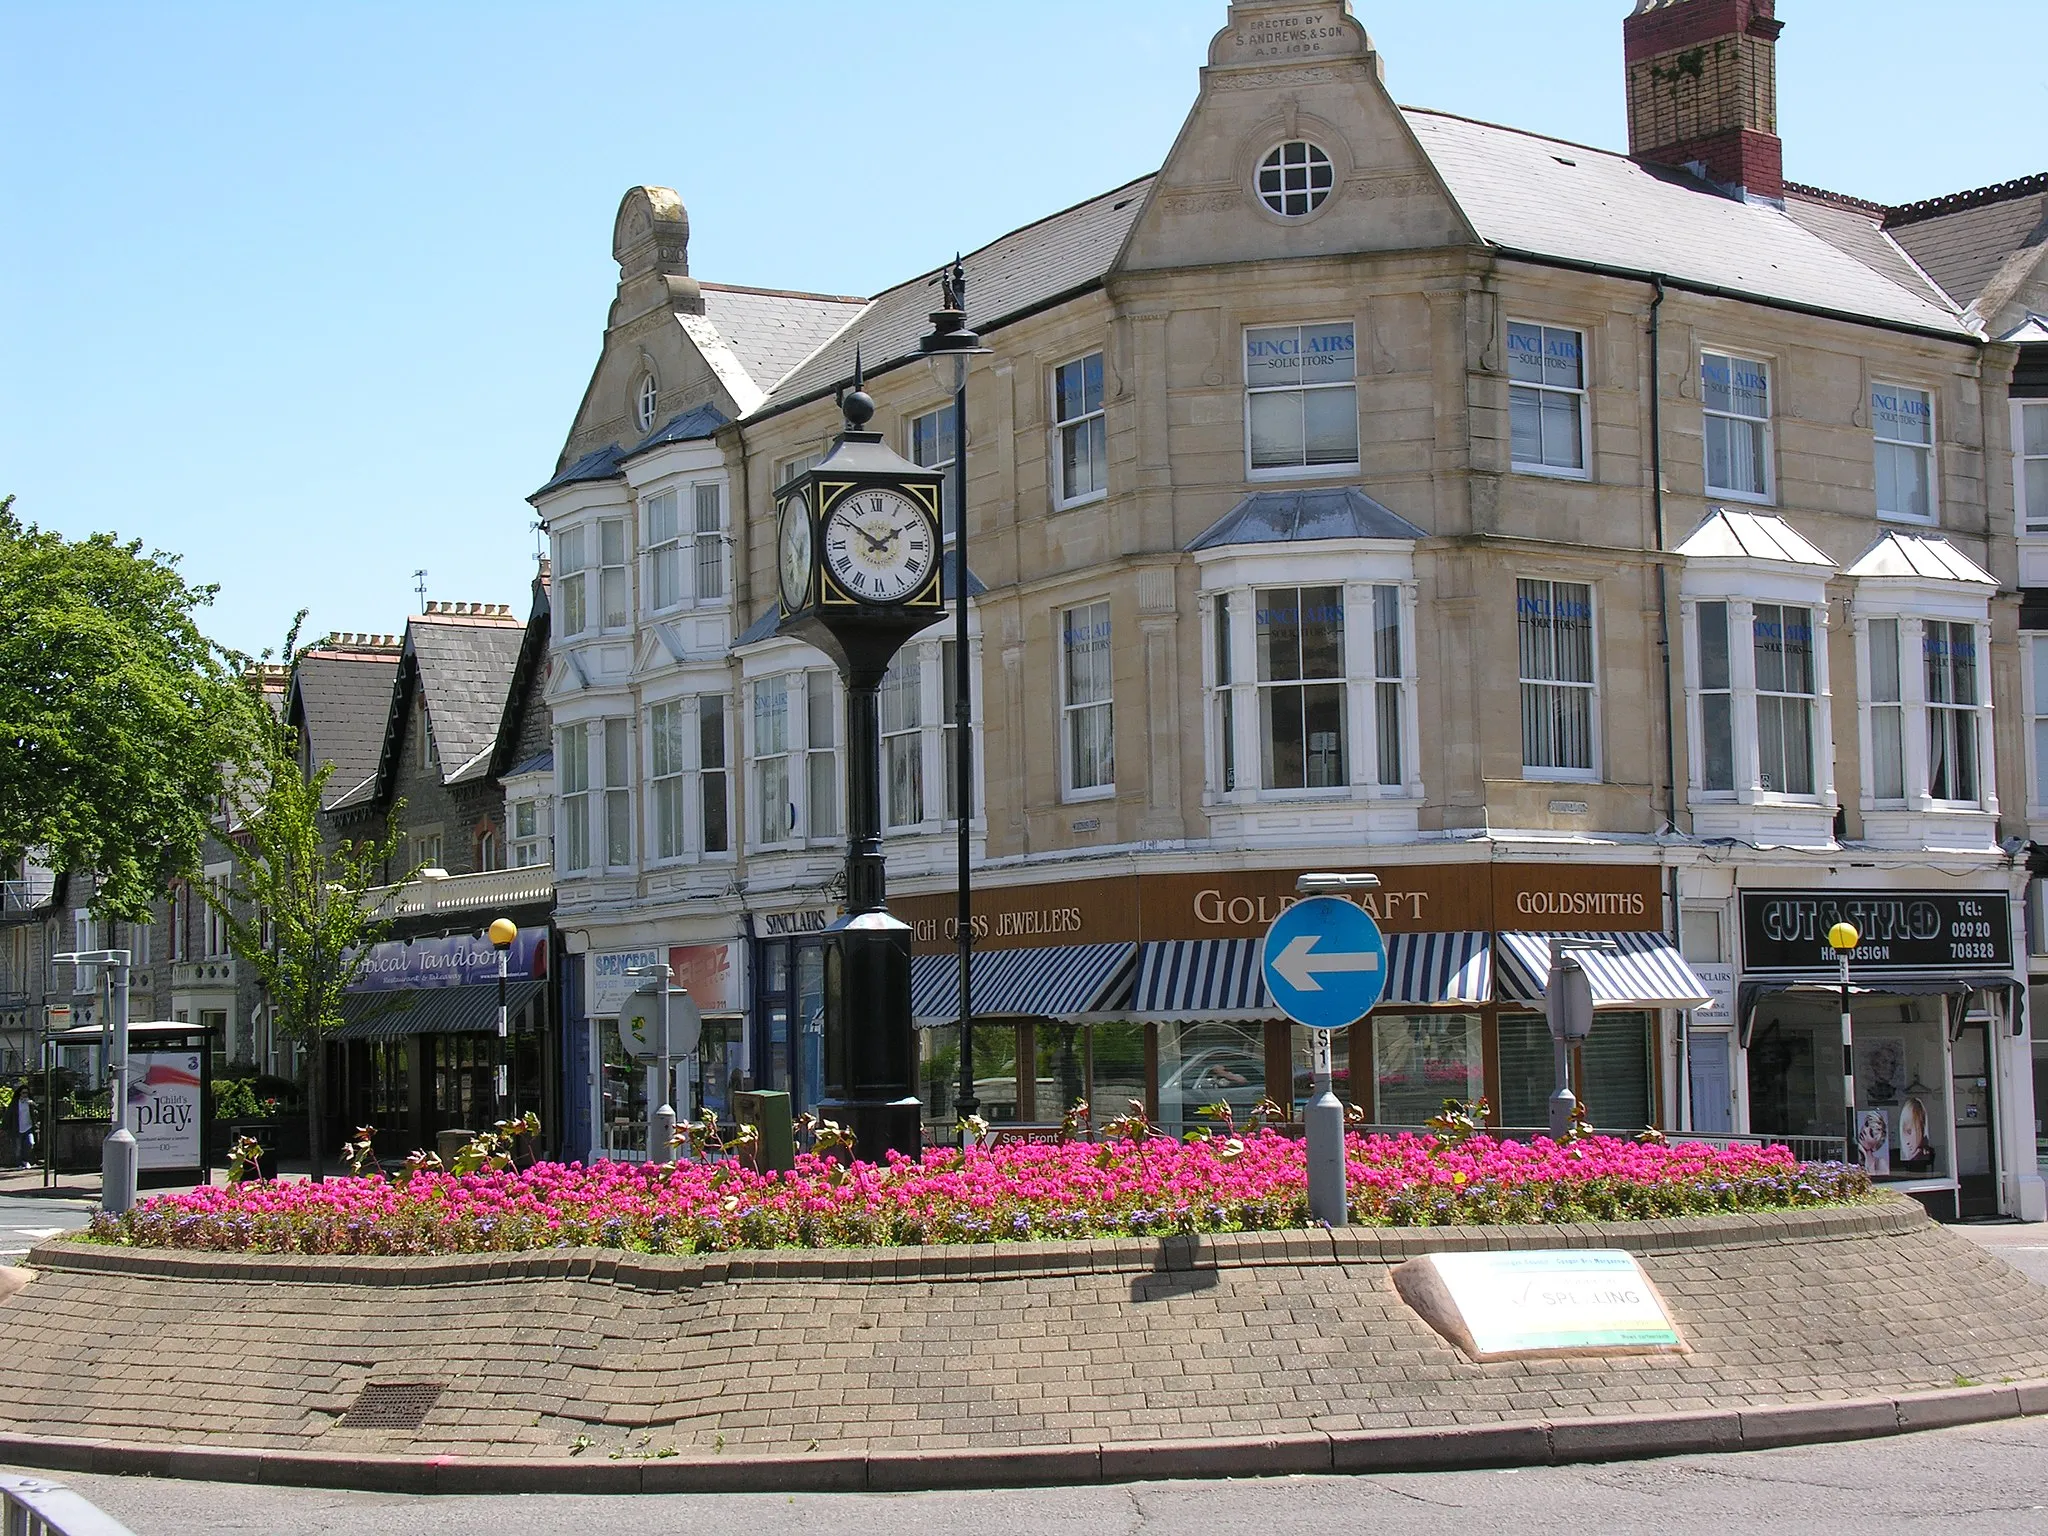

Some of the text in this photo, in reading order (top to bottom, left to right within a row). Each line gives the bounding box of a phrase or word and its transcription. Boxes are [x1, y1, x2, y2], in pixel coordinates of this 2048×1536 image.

[1250, 15, 1323, 30] ERECTED BY
[1248, 335, 1354, 357] SINCLAIRS
[1507, 334, 1583, 358] INCLAIRS
[1268, 354, 1334, 368] SOLICITORS
[1519, 353, 1567, 369] SOLICITORS
[851, 502, 865, 518] XI
[870, 498, 883, 512] XII
[832, 540, 846, 550] IX
[910, 541, 923, 550] III
[875, 578, 886, 592] VI
[1256, 605, 1344, 625] SINCLAIRS
[1517, 597, 1592, 619] INCLAIRS
[1516, 892, 1645, 914] GOLDSMITHS
[1958, 901, 1982, 917] TEL:
[766, 910, 826, 934] SINCLAIRS
[944, 915, 988, 940] CLSS
[996, 908, 1081, 936] JEWELLERS
[1762, 900, 1817, 941] CUT
[1844, 900, 1941, 940] STYLED
[1849, 946, 1889, 960] DESIGN
[1950, 942, 1995, 959] 708328
[160, 1095, 188, 1105] Child's
[136, 1097, 192, 1133] play.
[1002, 1132, 1059, 1143] Sea Front
[1542, 1290, 1640, 1306] SPELING
